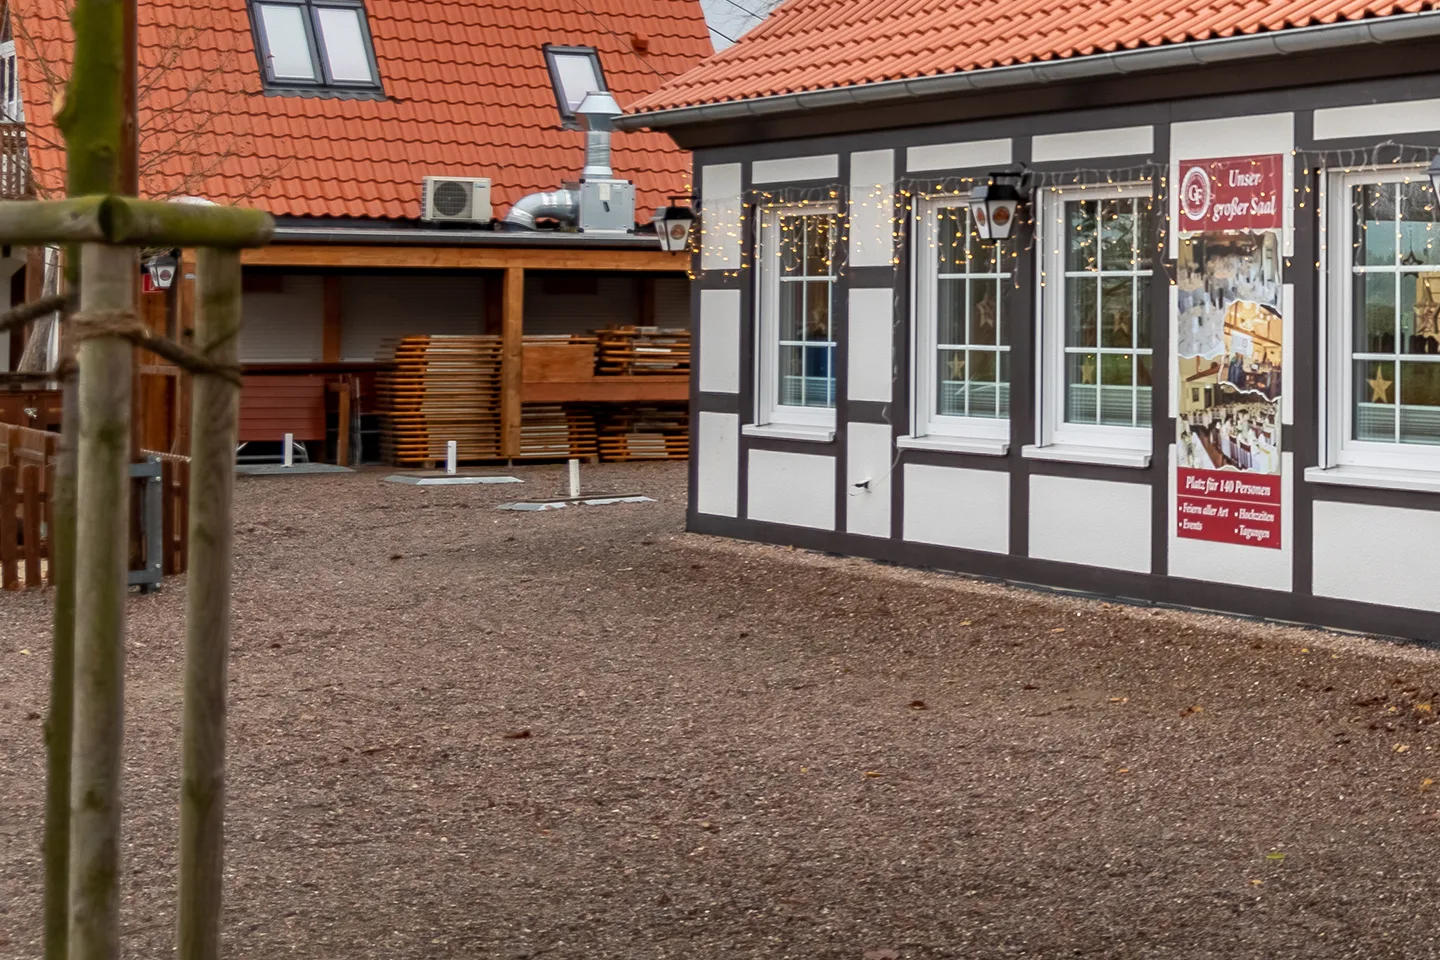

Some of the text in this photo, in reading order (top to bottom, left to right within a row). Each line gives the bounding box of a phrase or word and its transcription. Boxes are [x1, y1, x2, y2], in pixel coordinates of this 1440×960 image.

[1229, 169, 1261, 187] Unser
[1212, 195, 1276, 222] großer Saal
[1185, 476, 1271, 496] Platz für 140 Personen
[1182, 502, 1229, 517] Feiern aller Art
[1239, 508, 1275, 522] Hochzeiten
[1182, 518, 1203, 531] Events
[1239, 524, 1270, 541] Tagungen
